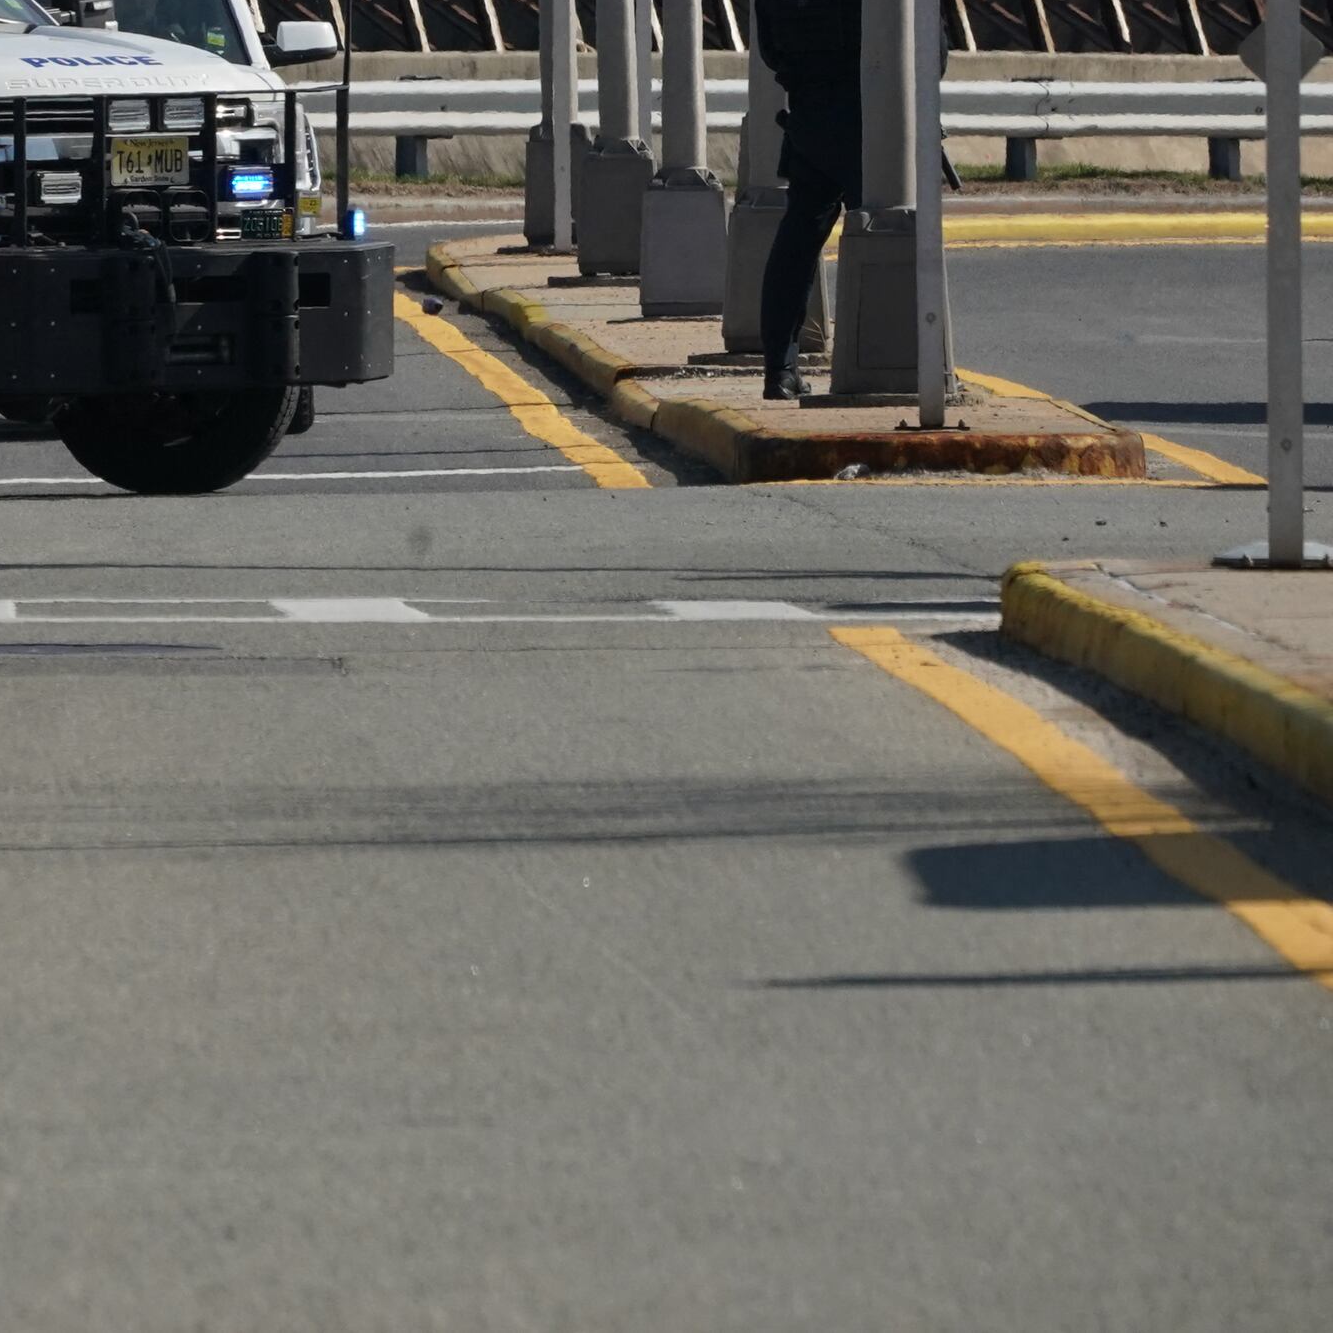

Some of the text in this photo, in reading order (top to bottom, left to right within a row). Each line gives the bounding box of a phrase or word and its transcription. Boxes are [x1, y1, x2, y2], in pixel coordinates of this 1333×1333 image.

[20, 55, 164, 68] POLICE
[6, 72, 211, 91] SUPER DUTY
